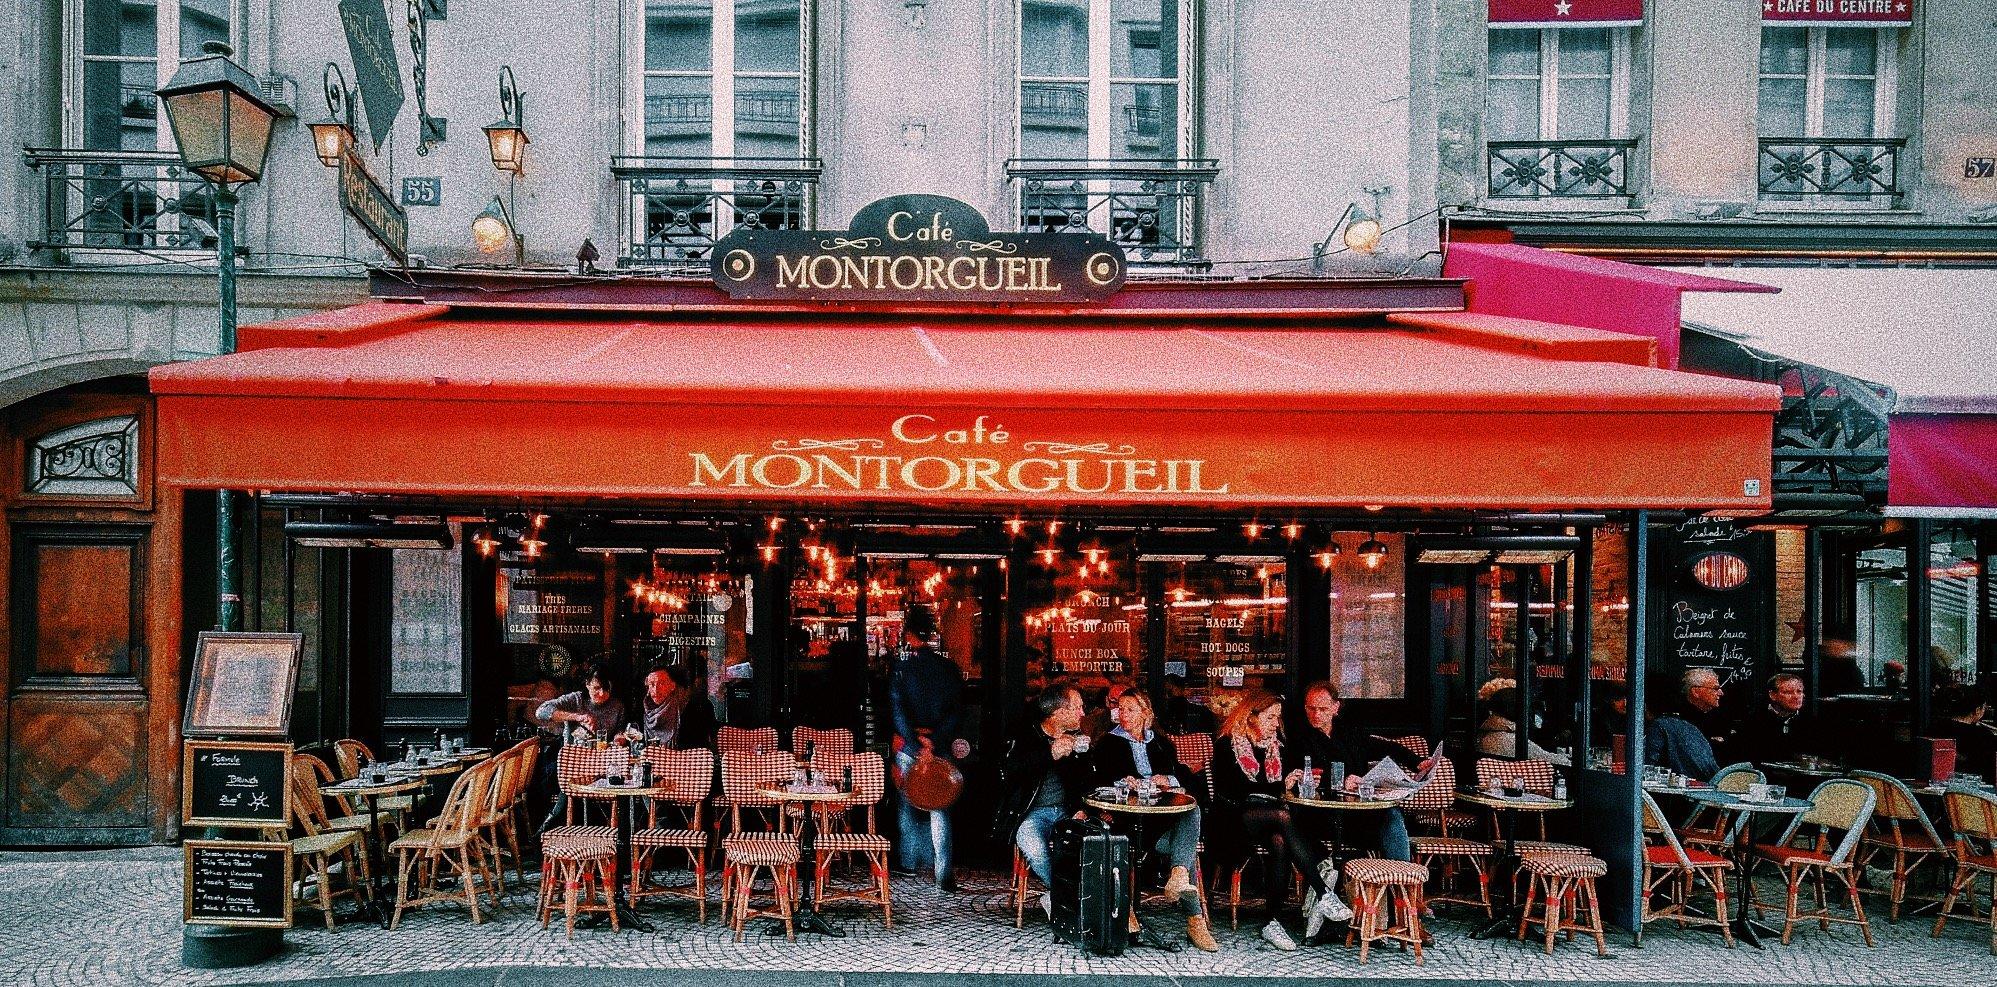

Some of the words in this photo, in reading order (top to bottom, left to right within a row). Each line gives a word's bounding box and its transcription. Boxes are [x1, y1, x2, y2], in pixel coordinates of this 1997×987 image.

[1816, 0, 1834, 13] DU
[1840, 0, 1892, 13] CENTRE
[1968, 159, 1993, 177] 57
[408, 180, 435, 201] 55
[343, 151, 405, 252] Restaurant
[887, 211, 952, 243] Café
[776, 255, 1061, 291] MONTORGUEIL
[891, 414, 1009, 445] Café
[688, 452, 1228, 495] MONTORGUEIL
[519, 605, 558, 614] MARIAGE
[1723, 608, 1736, 620] de
[659, 614, 725, 624] CHAMPAGNES
[1206, 618, 1245, 628] BAGELS
[509, 624, 540, 634] GLACES
[542, 625, 601, 634] ARTISANALES
[1044, 622, 1079, 633] PLATS
[1083, 622, 1097, 633] DU
[1101, 623, 1130, 633] JOUR
[1719, 629, 1747, 640] sauce
[668, 636, 716, 646] DIGESTIFS
[1056, 648, 1092, 659] LUNCH
[1097, 648, 1119, 659] BOX
[1201, 643, 1222, 653] HOT
[1226, 643, 1250, 653] DOGS
[1063, 661, 1123, 672] EMPORTER
[1207, 666, 1245, 678] SOUPES
